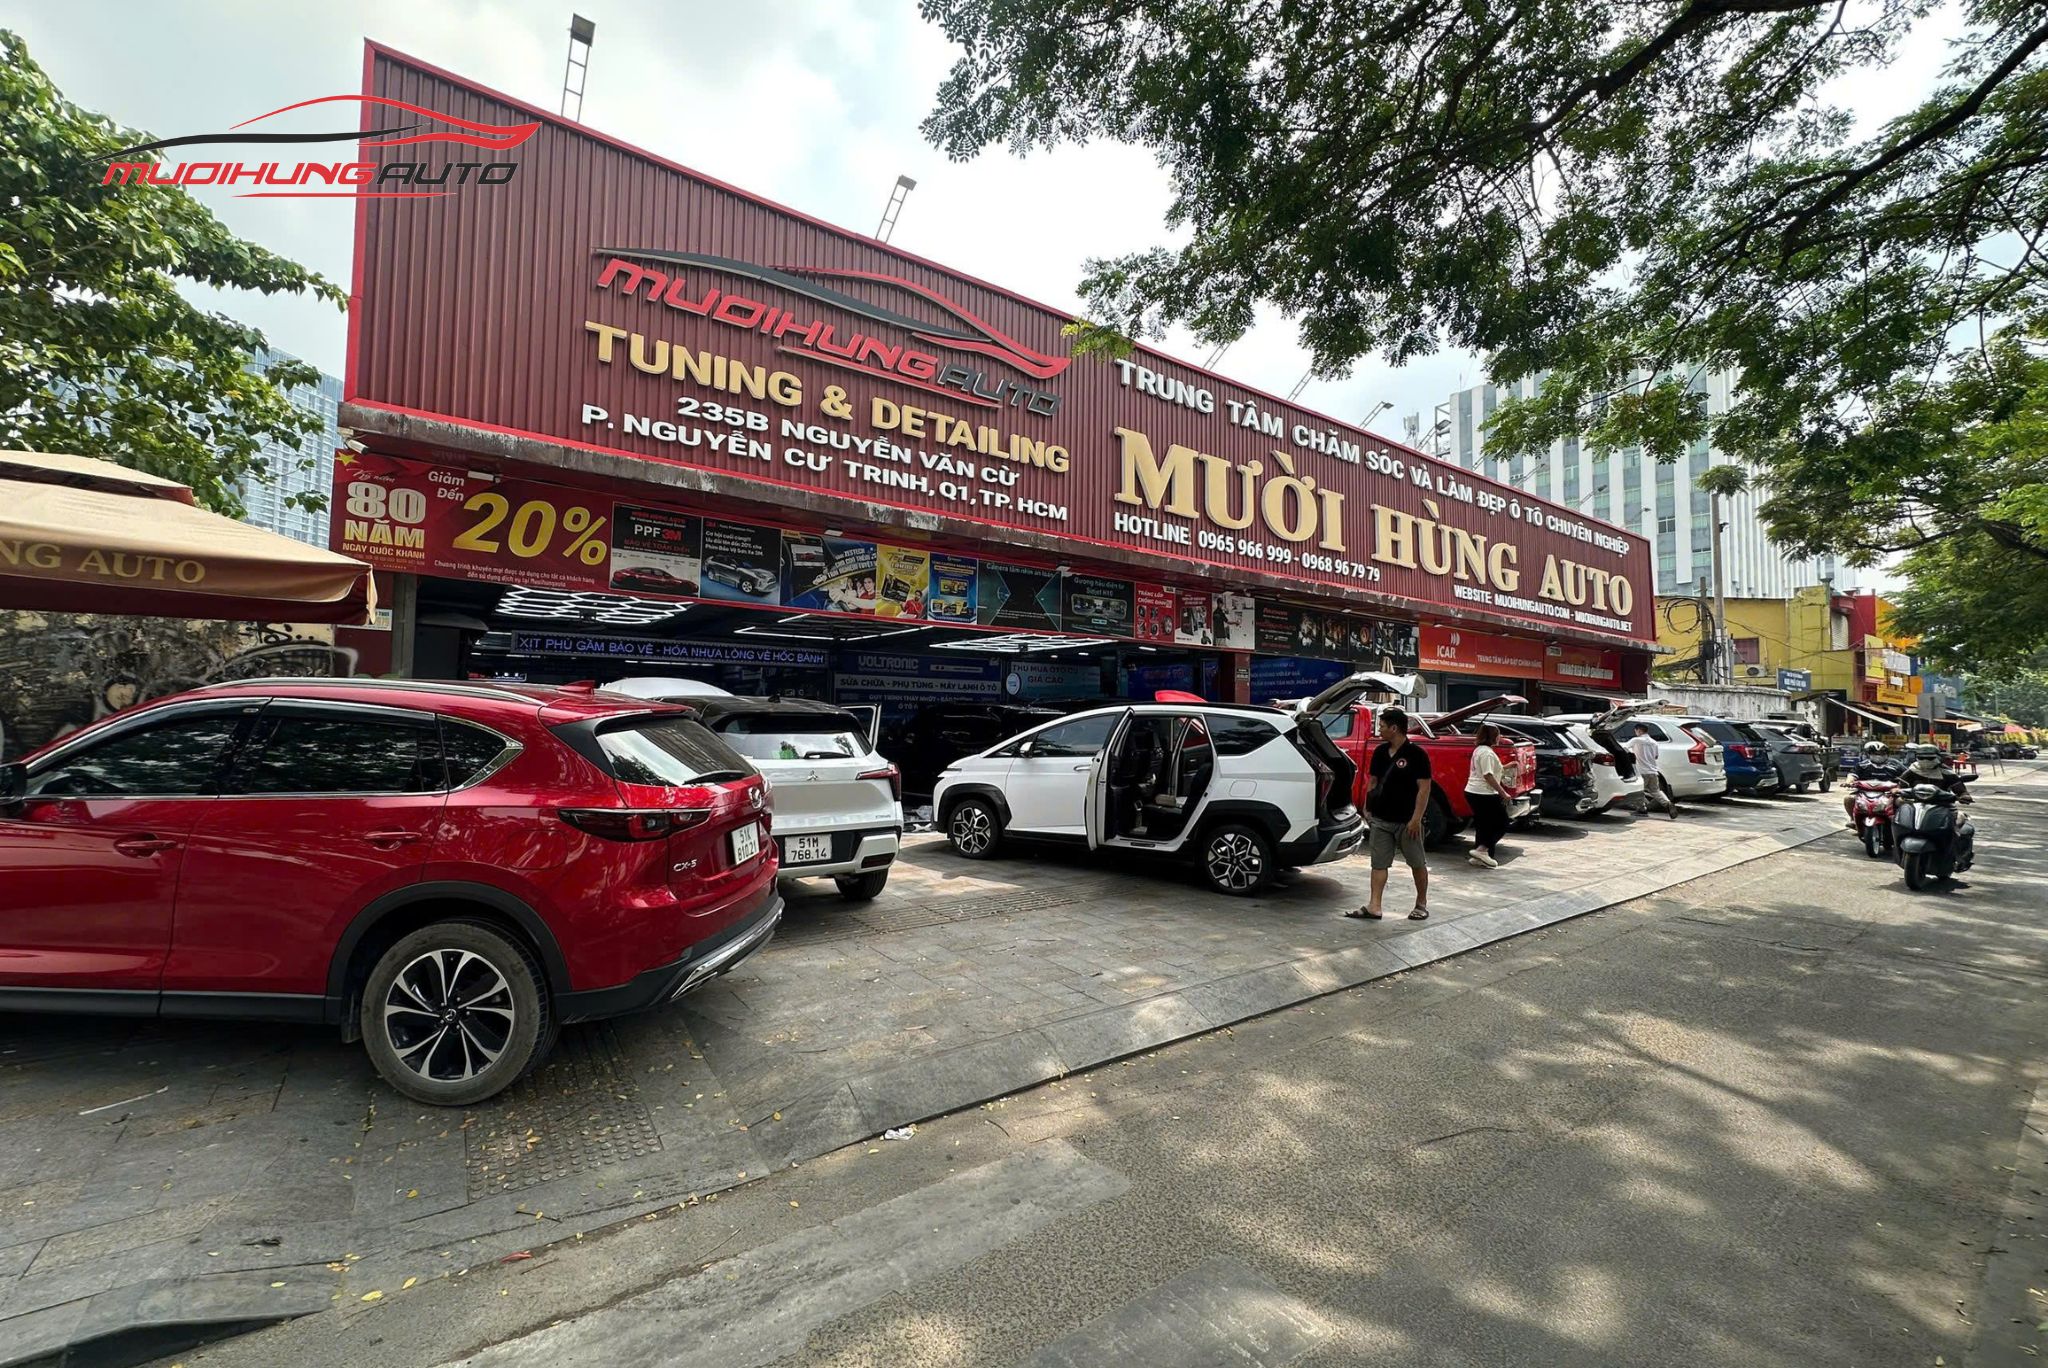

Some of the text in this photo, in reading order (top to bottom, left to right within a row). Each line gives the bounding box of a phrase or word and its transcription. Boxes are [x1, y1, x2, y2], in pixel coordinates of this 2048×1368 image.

[585, 320, 1070, 473] TUNING & DETAILING
[678, 396, 1020, 487] 235B NGUYỄN VĂN CỪ
[1115, 357, 1630, 558] TRUNG TÂM CHĂM SÓC VÀ LÀM ĐẸP Ô TÔ CHUYÊN NGHIỆP
[428, 470, 465, 487] Giảm
[582, 404, 614, 429] P.
[623, 413, 772, 461] NGUYỄN
[784, 448, 833, 472] CƯ
[1017, 497, 1068, 520] HCM
[346, 481, 427, 524] 80
[437, 486, 465, 502] Đến
[344, 518, 426, 549] NĂM
[452, 492, 608, 567] 20%
[634, 524, 661, 537] PPF
[1114, 426, 1633, 616] MƯỜI HÙNG AUTO
[77, 549, 206, 583] AUTO
[1198, 530, 1235, 553] 0965
[1238, 540, 1263, 559] 966
[1266, 544, 1292, 564] 999
[1301, 552, 1332, 571] 0968
[1436, 645, 1456, 659] ICAR
[791, 847, 827, 861] 768.14
[799, 837, 819, 848] 51M
[673, 859, 698, 872] CX-5
